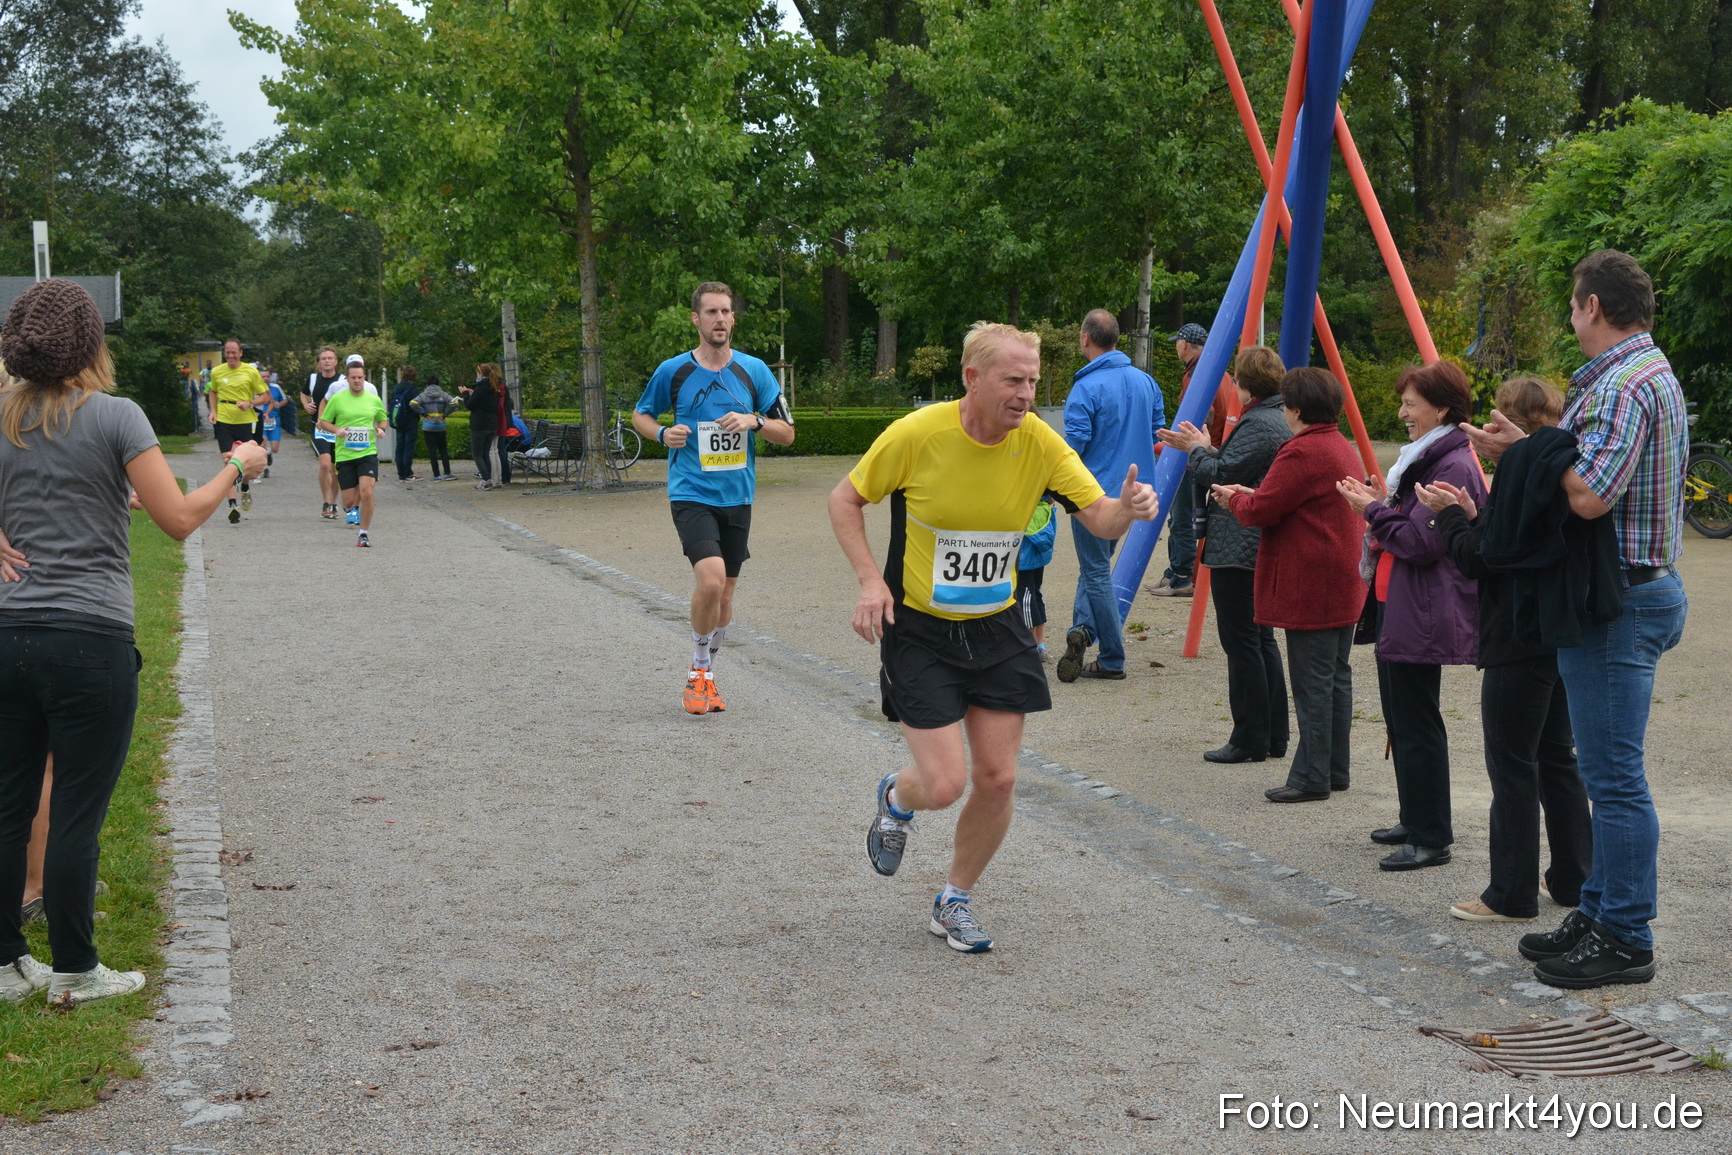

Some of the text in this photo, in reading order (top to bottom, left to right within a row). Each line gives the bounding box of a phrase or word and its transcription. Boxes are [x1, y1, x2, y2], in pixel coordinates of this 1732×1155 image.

[347, 432, 368, 442] 2281
[710, 432, 741, 452] 652
[706, 455, 740, 465] MARIO
[937, 538, 1010, 548] PARTL Neumarkt
[943, 551, 1011, 583] 3401
